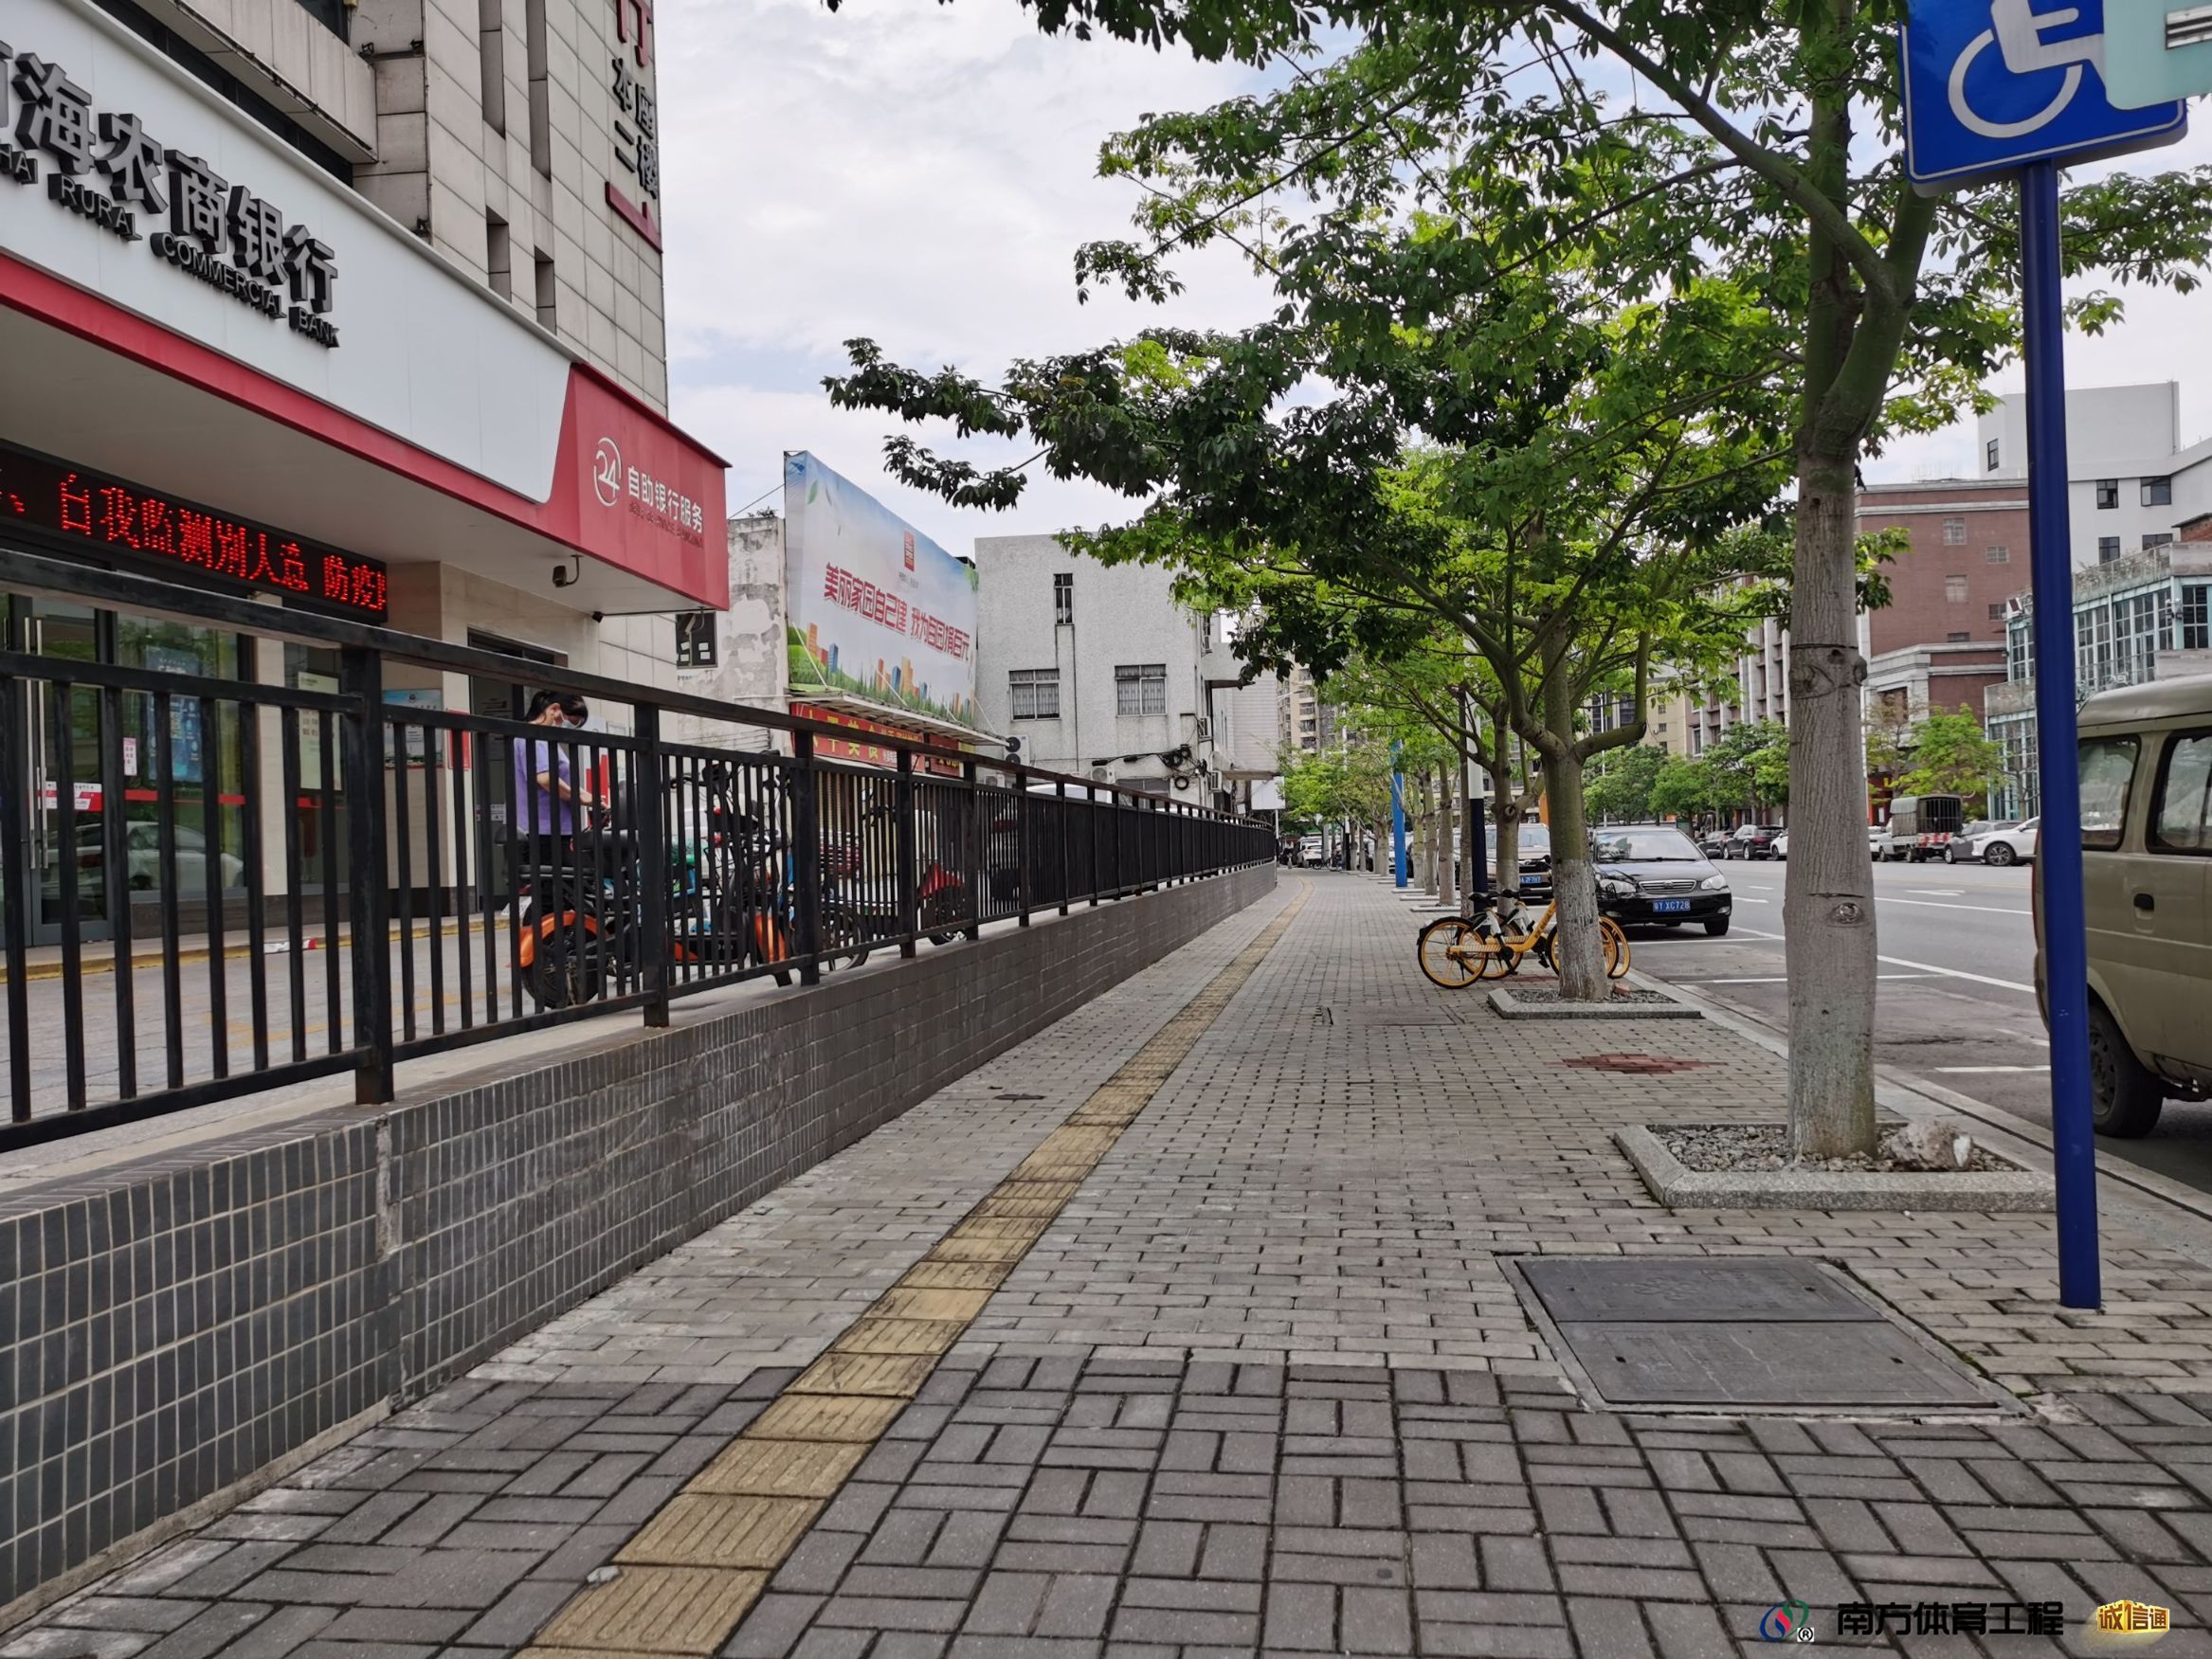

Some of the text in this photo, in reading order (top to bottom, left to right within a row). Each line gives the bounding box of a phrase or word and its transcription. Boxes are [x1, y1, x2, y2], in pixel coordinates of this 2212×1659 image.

[0, 41, 338, 313] 海农商银行
[47, 173, 143, 241] RURAL
[150, 232, 287, 319] COMMERCIAL
[289, 306, 339, 348] BANK
[627, 465, 702, 533] 自助银行服务
[824, 562, 907, 634] 美丽家园自己建
